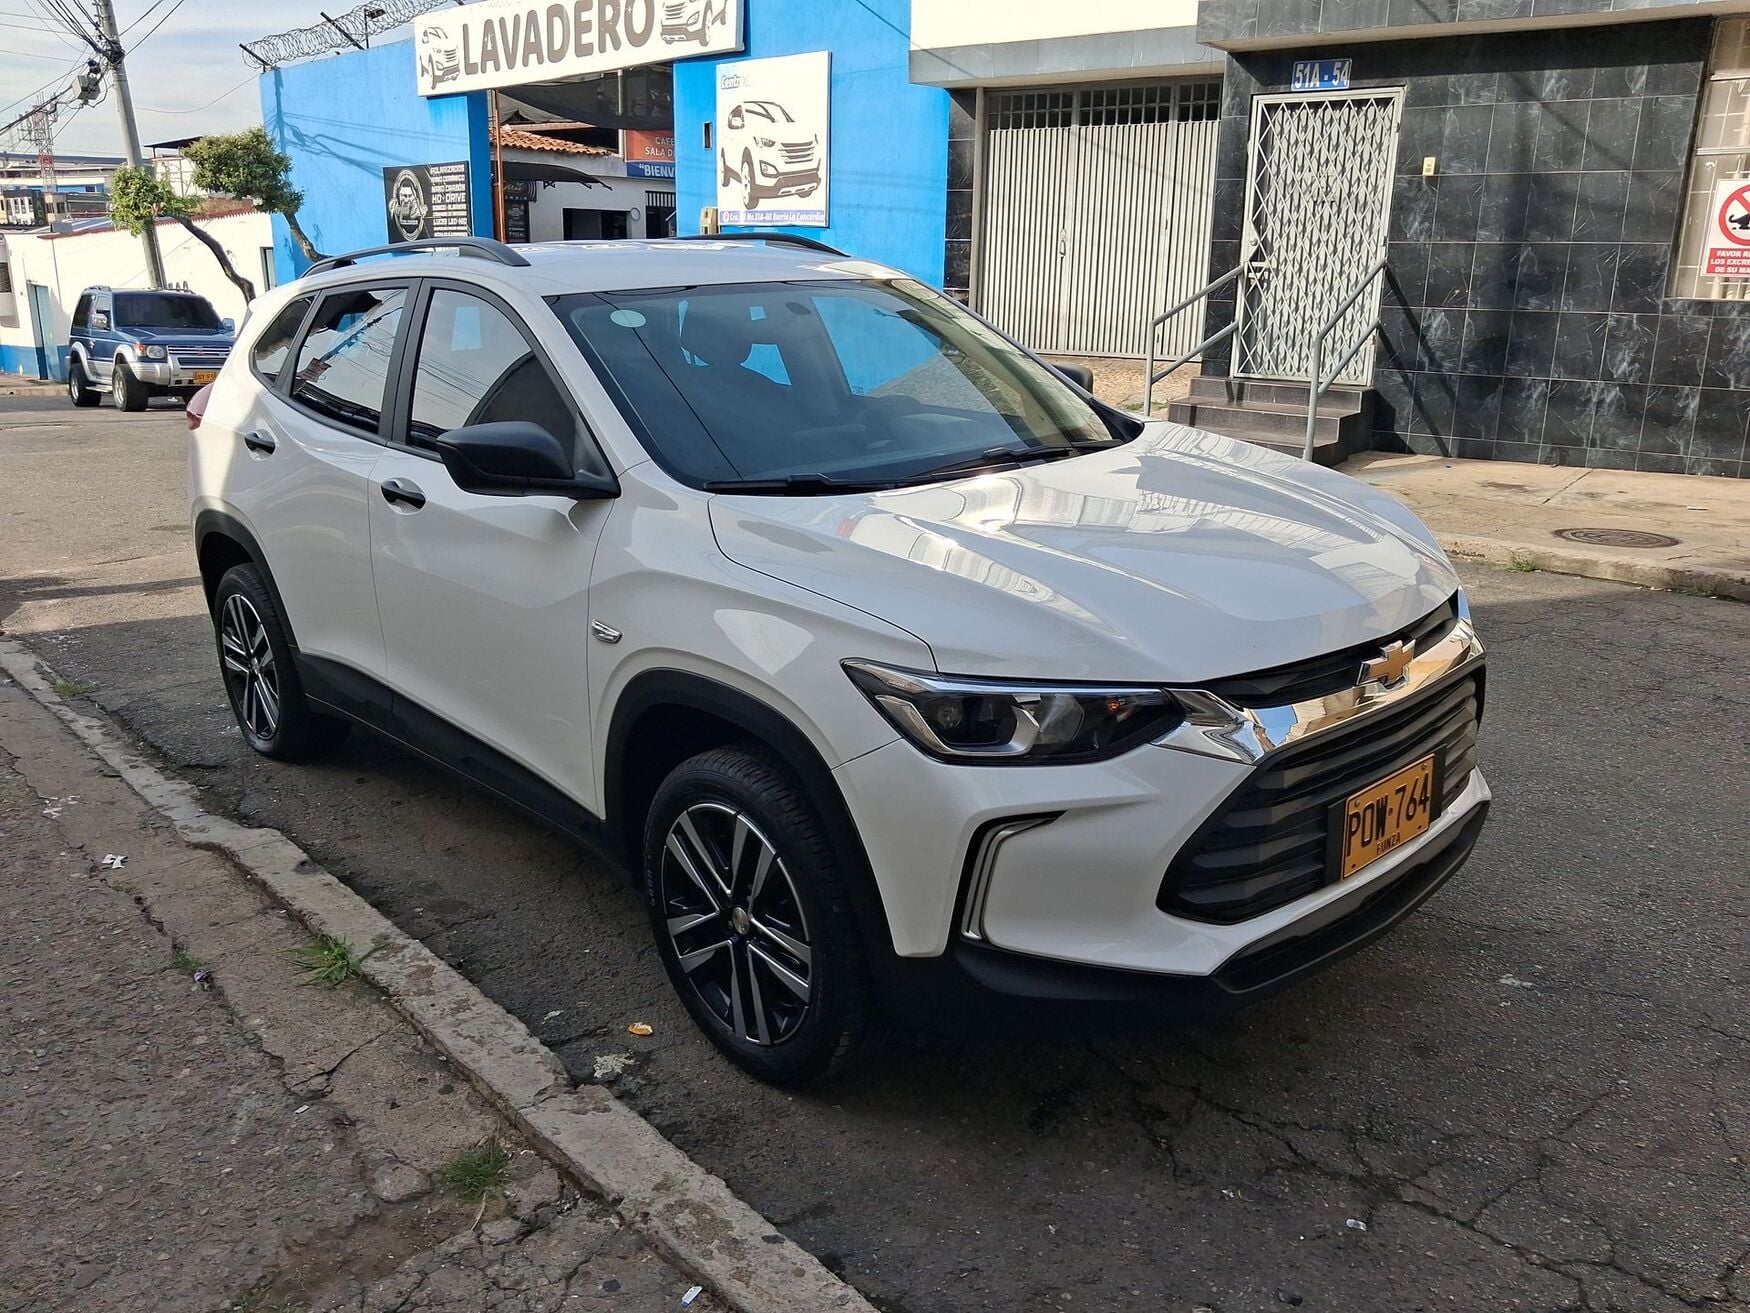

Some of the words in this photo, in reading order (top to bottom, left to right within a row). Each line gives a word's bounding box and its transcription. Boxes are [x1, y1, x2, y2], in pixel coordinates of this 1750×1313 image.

[462, 0, 655, 75] LAVADERO
[1295, 63, 1320, 88] 51A
[1331, 61, 1350, 86] 54
[645, 146, 665, 157] SALA
[1716, 250, 1742, 258] FAVOR
